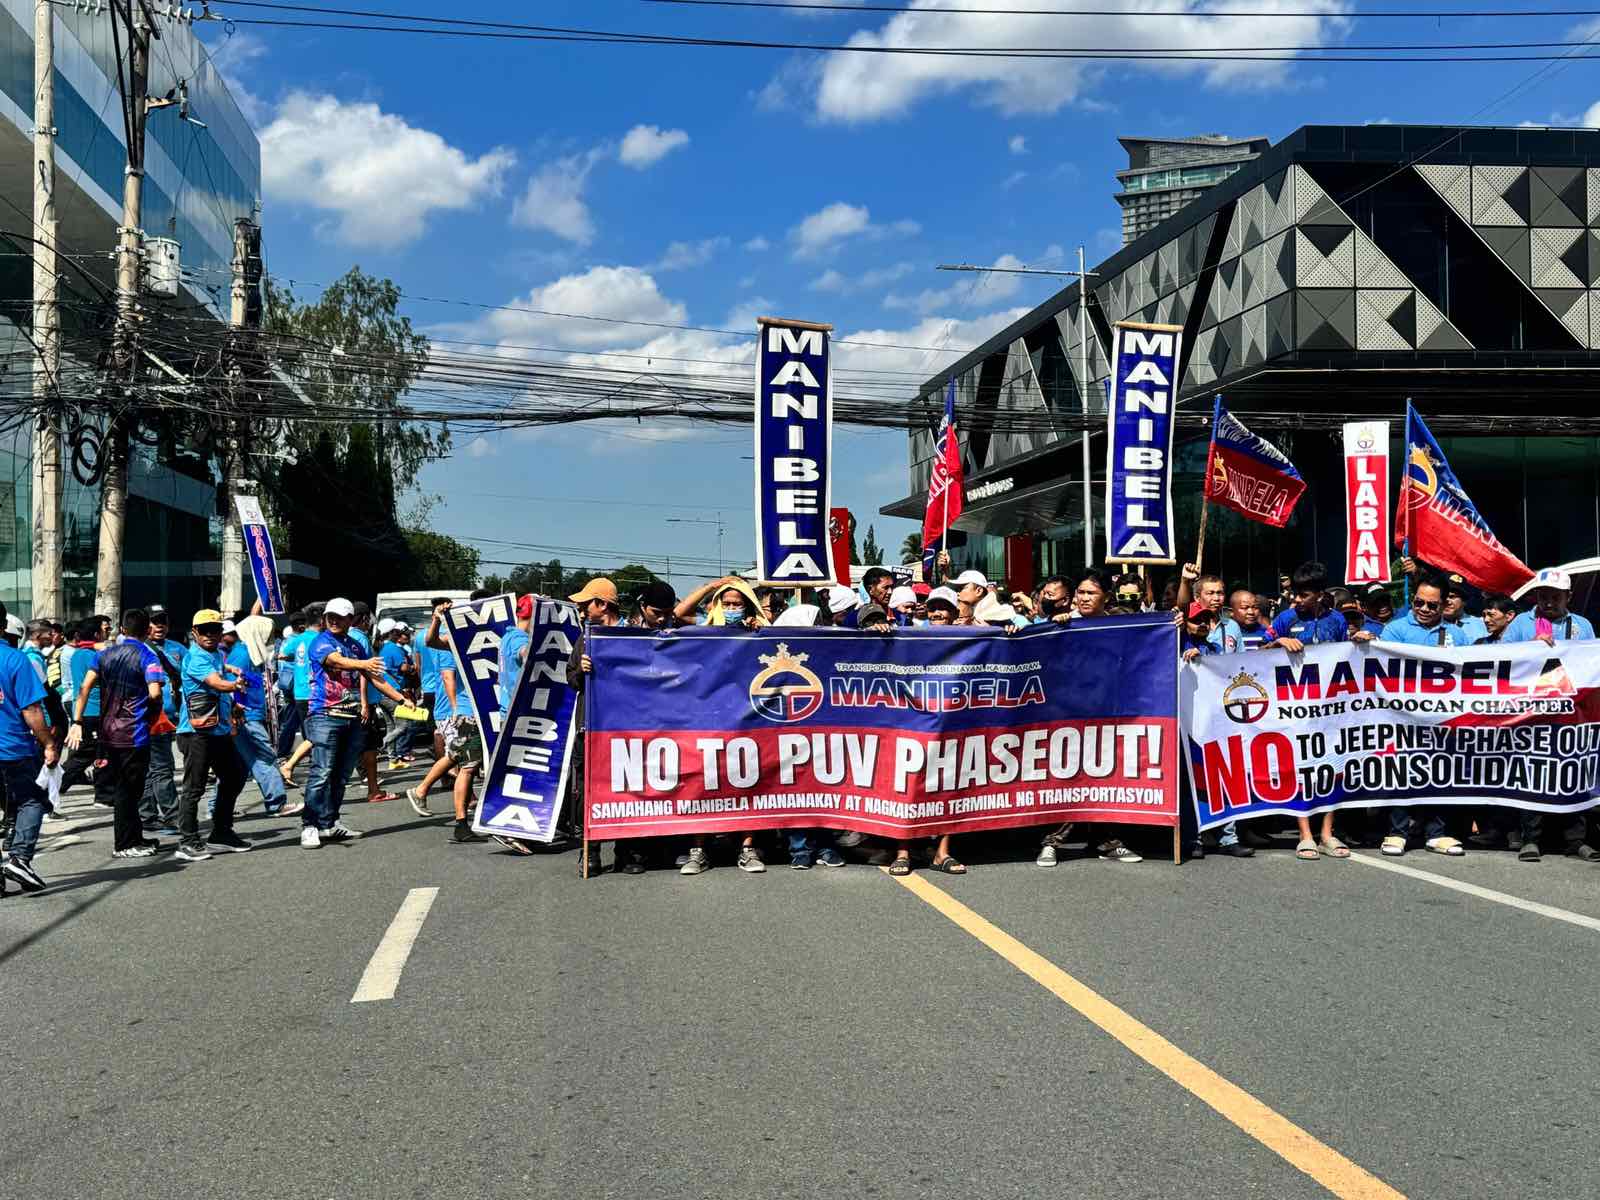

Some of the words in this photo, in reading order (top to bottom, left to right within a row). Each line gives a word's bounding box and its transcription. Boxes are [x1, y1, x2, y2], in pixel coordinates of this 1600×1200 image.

[768, 327, 825, 578] MANIBELA
[1118, 331, 1173, 556] MANIBELA
[1355, 457, 1380, 580] LABAN
[829, 675, 1046, 714] MANIBELA
[1275, 657, 1578, 701] MANIBELA
[486, 600, 580, 833] MANIBELA
[1278, 701, 1346, 720] NORTH
[1350, 697, 1465, 713] CALOOCAN
[1471, 698, 1575, 714] CHAPTER
[610, 737, 680, 793] NO
[696, 737, 760, 791] TO
[778, 733, 879, 788] PUV
[894, 724, 1162, 793] PHASEOUT!
[1296, 732, 1326, 760] TO
[1334, 723, 1451, 756] JEEPNEY
[1456, 726, 1551, 755] PHASE
[1557, 722, 1600, 757] OUT
[1202, 731, 1299, 816] NO
[1300, 764, 1336, 800] TO
[1342, 752, 1599, 795] CONSOLIDATION
[591, 800, 673, 819] SAMAHANG
[677, 797, 750, 816] MANIBELA
[753, 793, 841, 811] MANANAKAY
[846, 795, 862, 812] AT
[864, 797, 944, 820] NAGKAISANG
[949, 792, 1012, 814] TERMINAL
[1016, 791, 1035, 807] NG
[1038, 786, 1164, 806] TRANSPORTASYON
